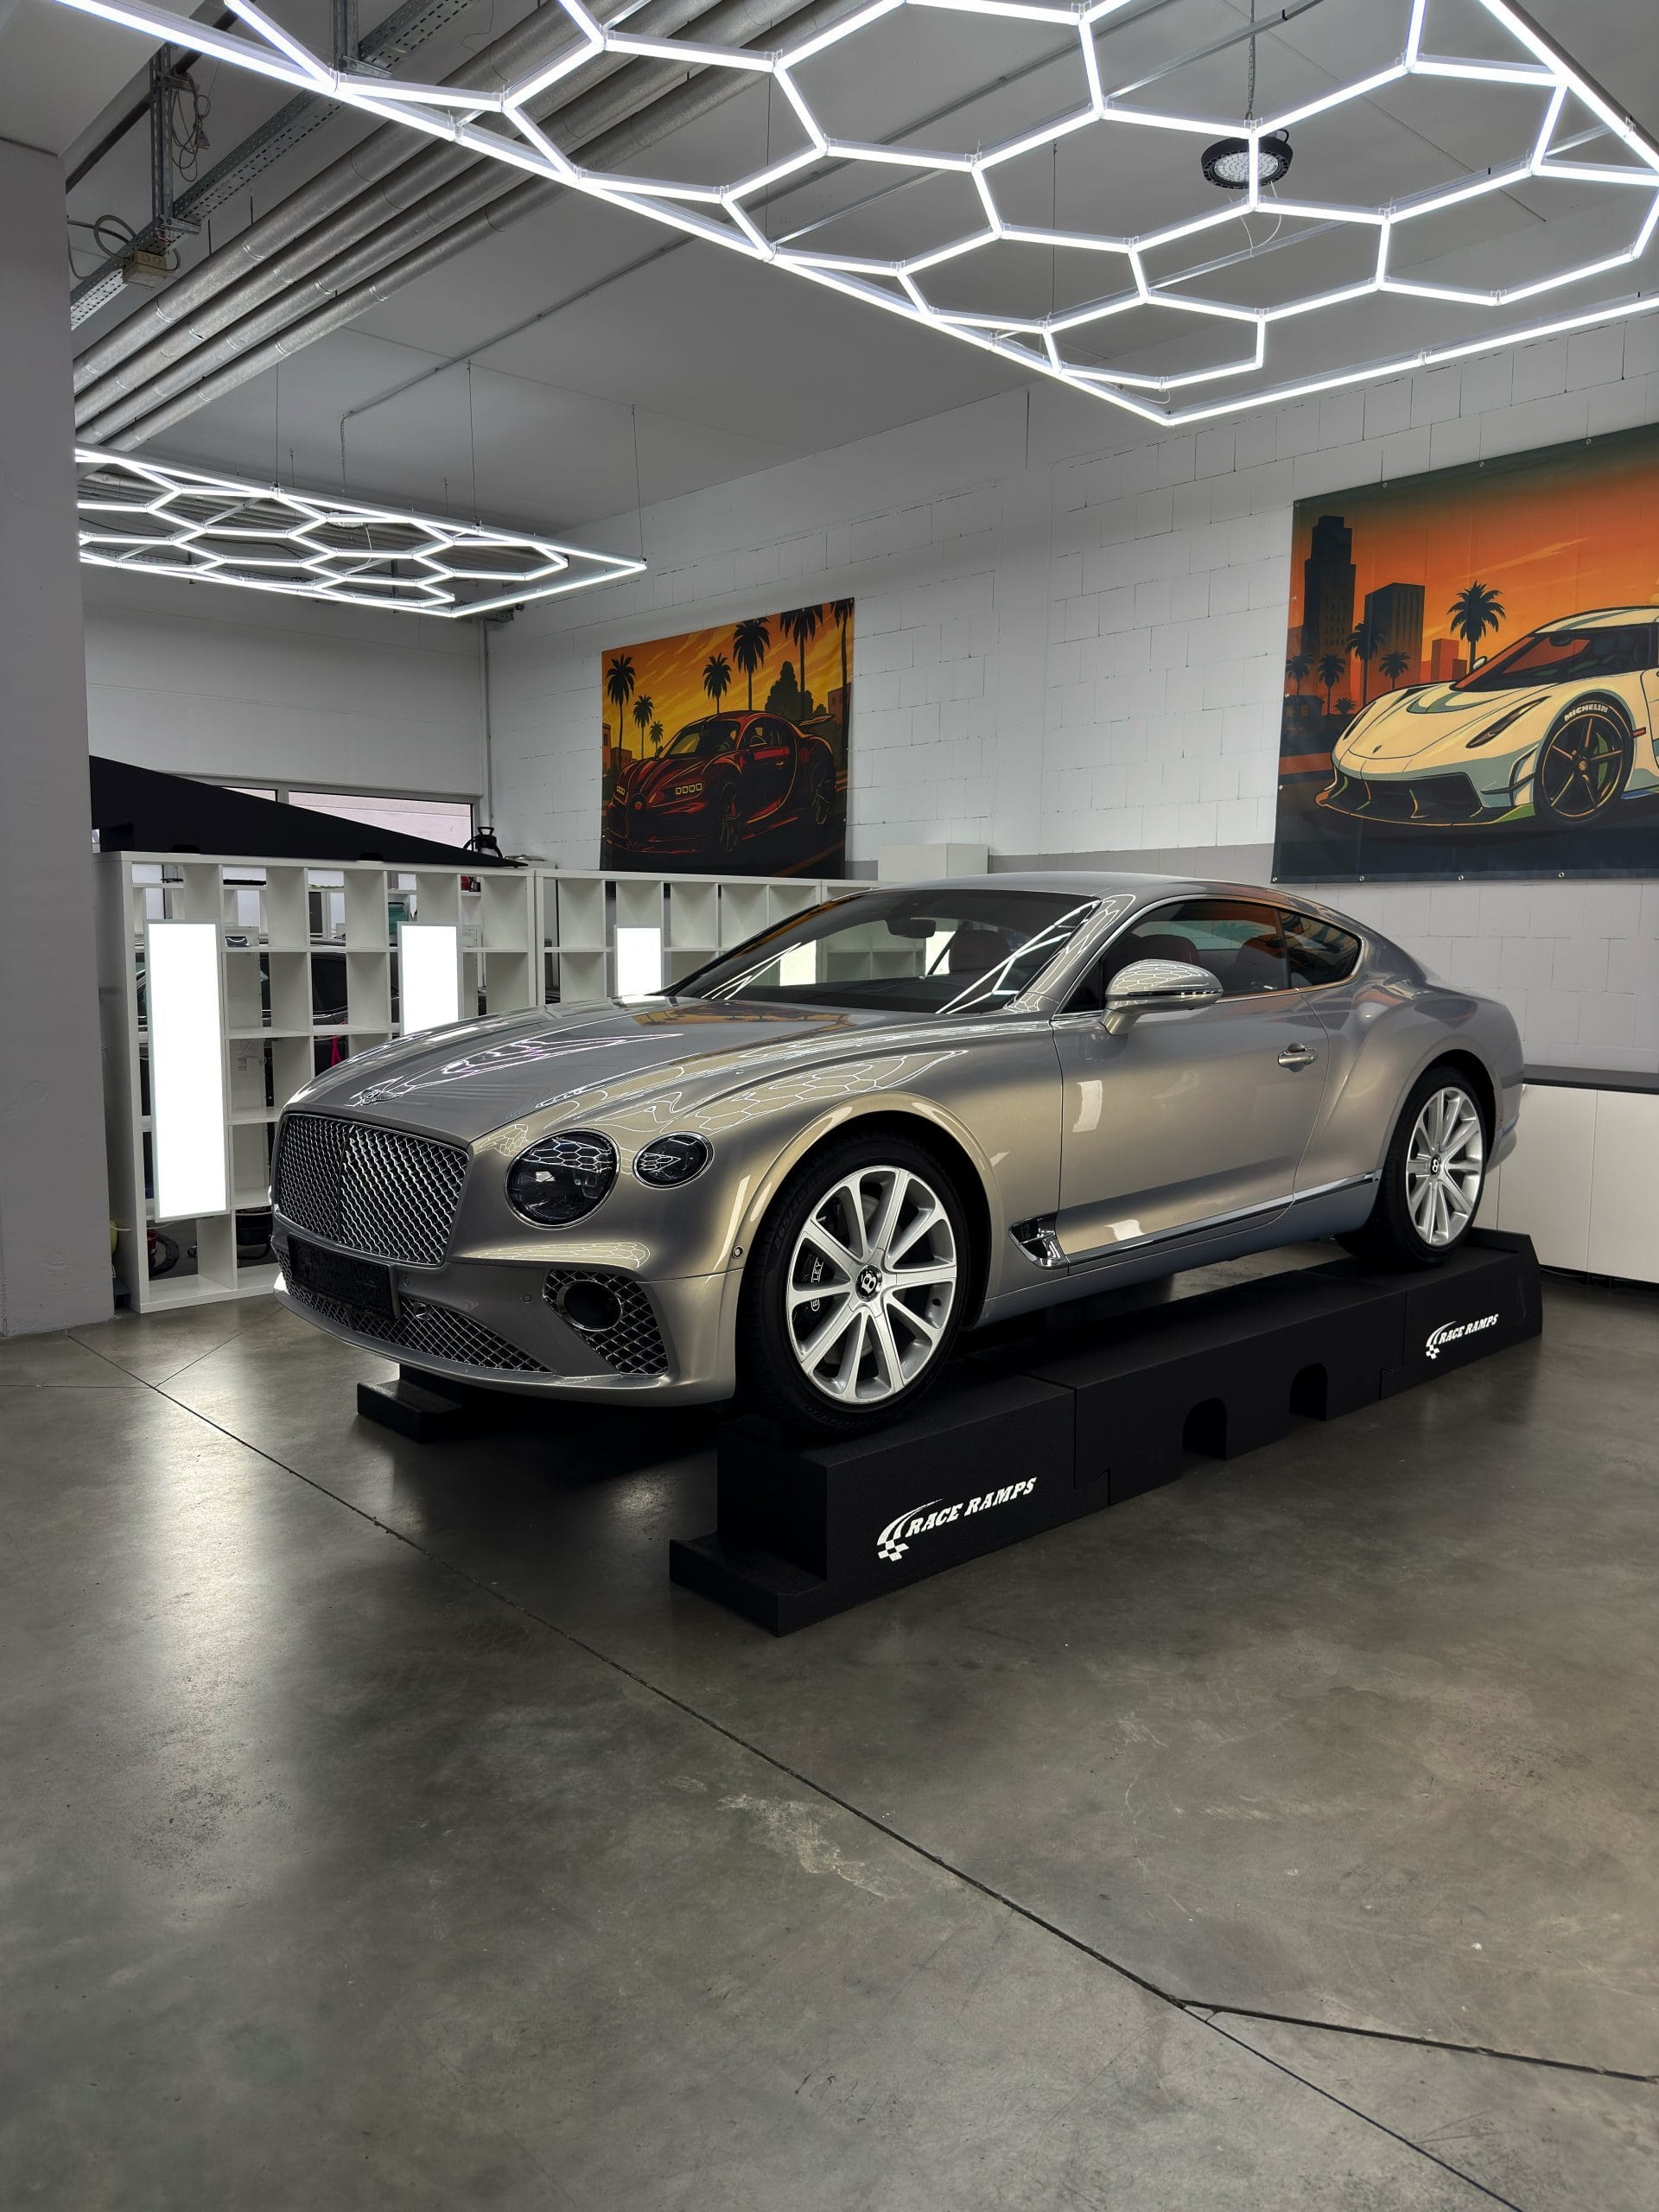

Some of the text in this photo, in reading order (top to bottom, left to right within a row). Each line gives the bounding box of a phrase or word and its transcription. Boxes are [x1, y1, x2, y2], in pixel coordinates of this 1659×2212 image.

[1564, 703, 1608, 721] MICHELIN
[861, 1272, 877, 1294] B
[1438, 1313, 1499, 1344] RACE RAMPS
[906, 1477, 1038, 1538] RACE RAMPS
